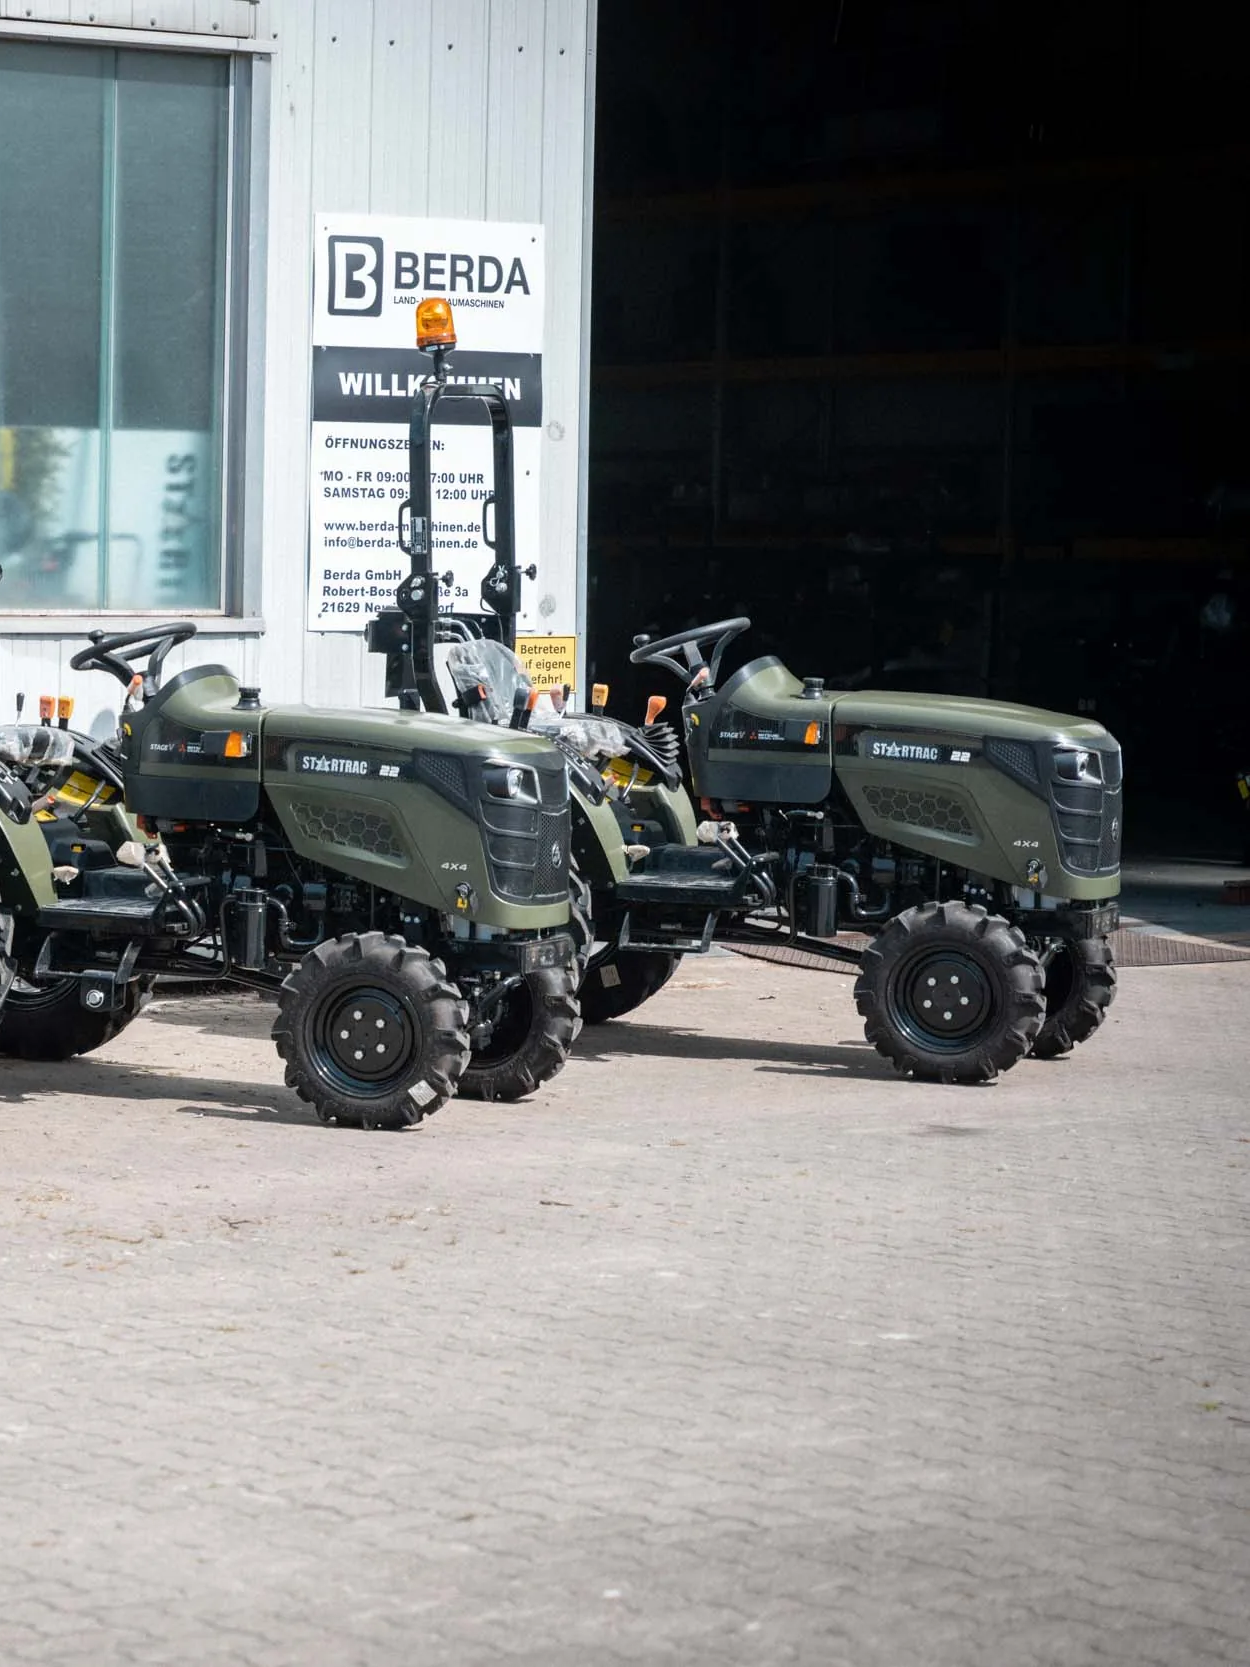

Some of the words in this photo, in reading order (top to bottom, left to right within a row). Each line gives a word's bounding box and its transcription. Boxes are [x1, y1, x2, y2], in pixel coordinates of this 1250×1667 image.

[334, 242, 377, 310] B
[395, 251, 531, 296] BERDA
[393, 296, 419, 305] LAND-
[444, 297, 505, 309] AUMASCHINEN
[323, 470, 343, 481] MO
[356, 471, 372, 482] FR
[429, 472, 455, 484] 7:00
[459, 473, 484, 484] UHR
[323, 487, 385, 498] SAMSTAG
[435, 489, 467, 500] 12:00
[323, 569, 360, 580] Berda
[365, 569, 401, 581] GmbH
[454, 587, 469, 597] 3a
[321, 602, 360, 613] 21629
[520, 644, 566, 655] Betreten
[535, 659, 571, 671] eigene
[531, 674, 563, 685] efahr!
[950, 750, 971, 763] 22
[379, 764, 400, 778] 22
